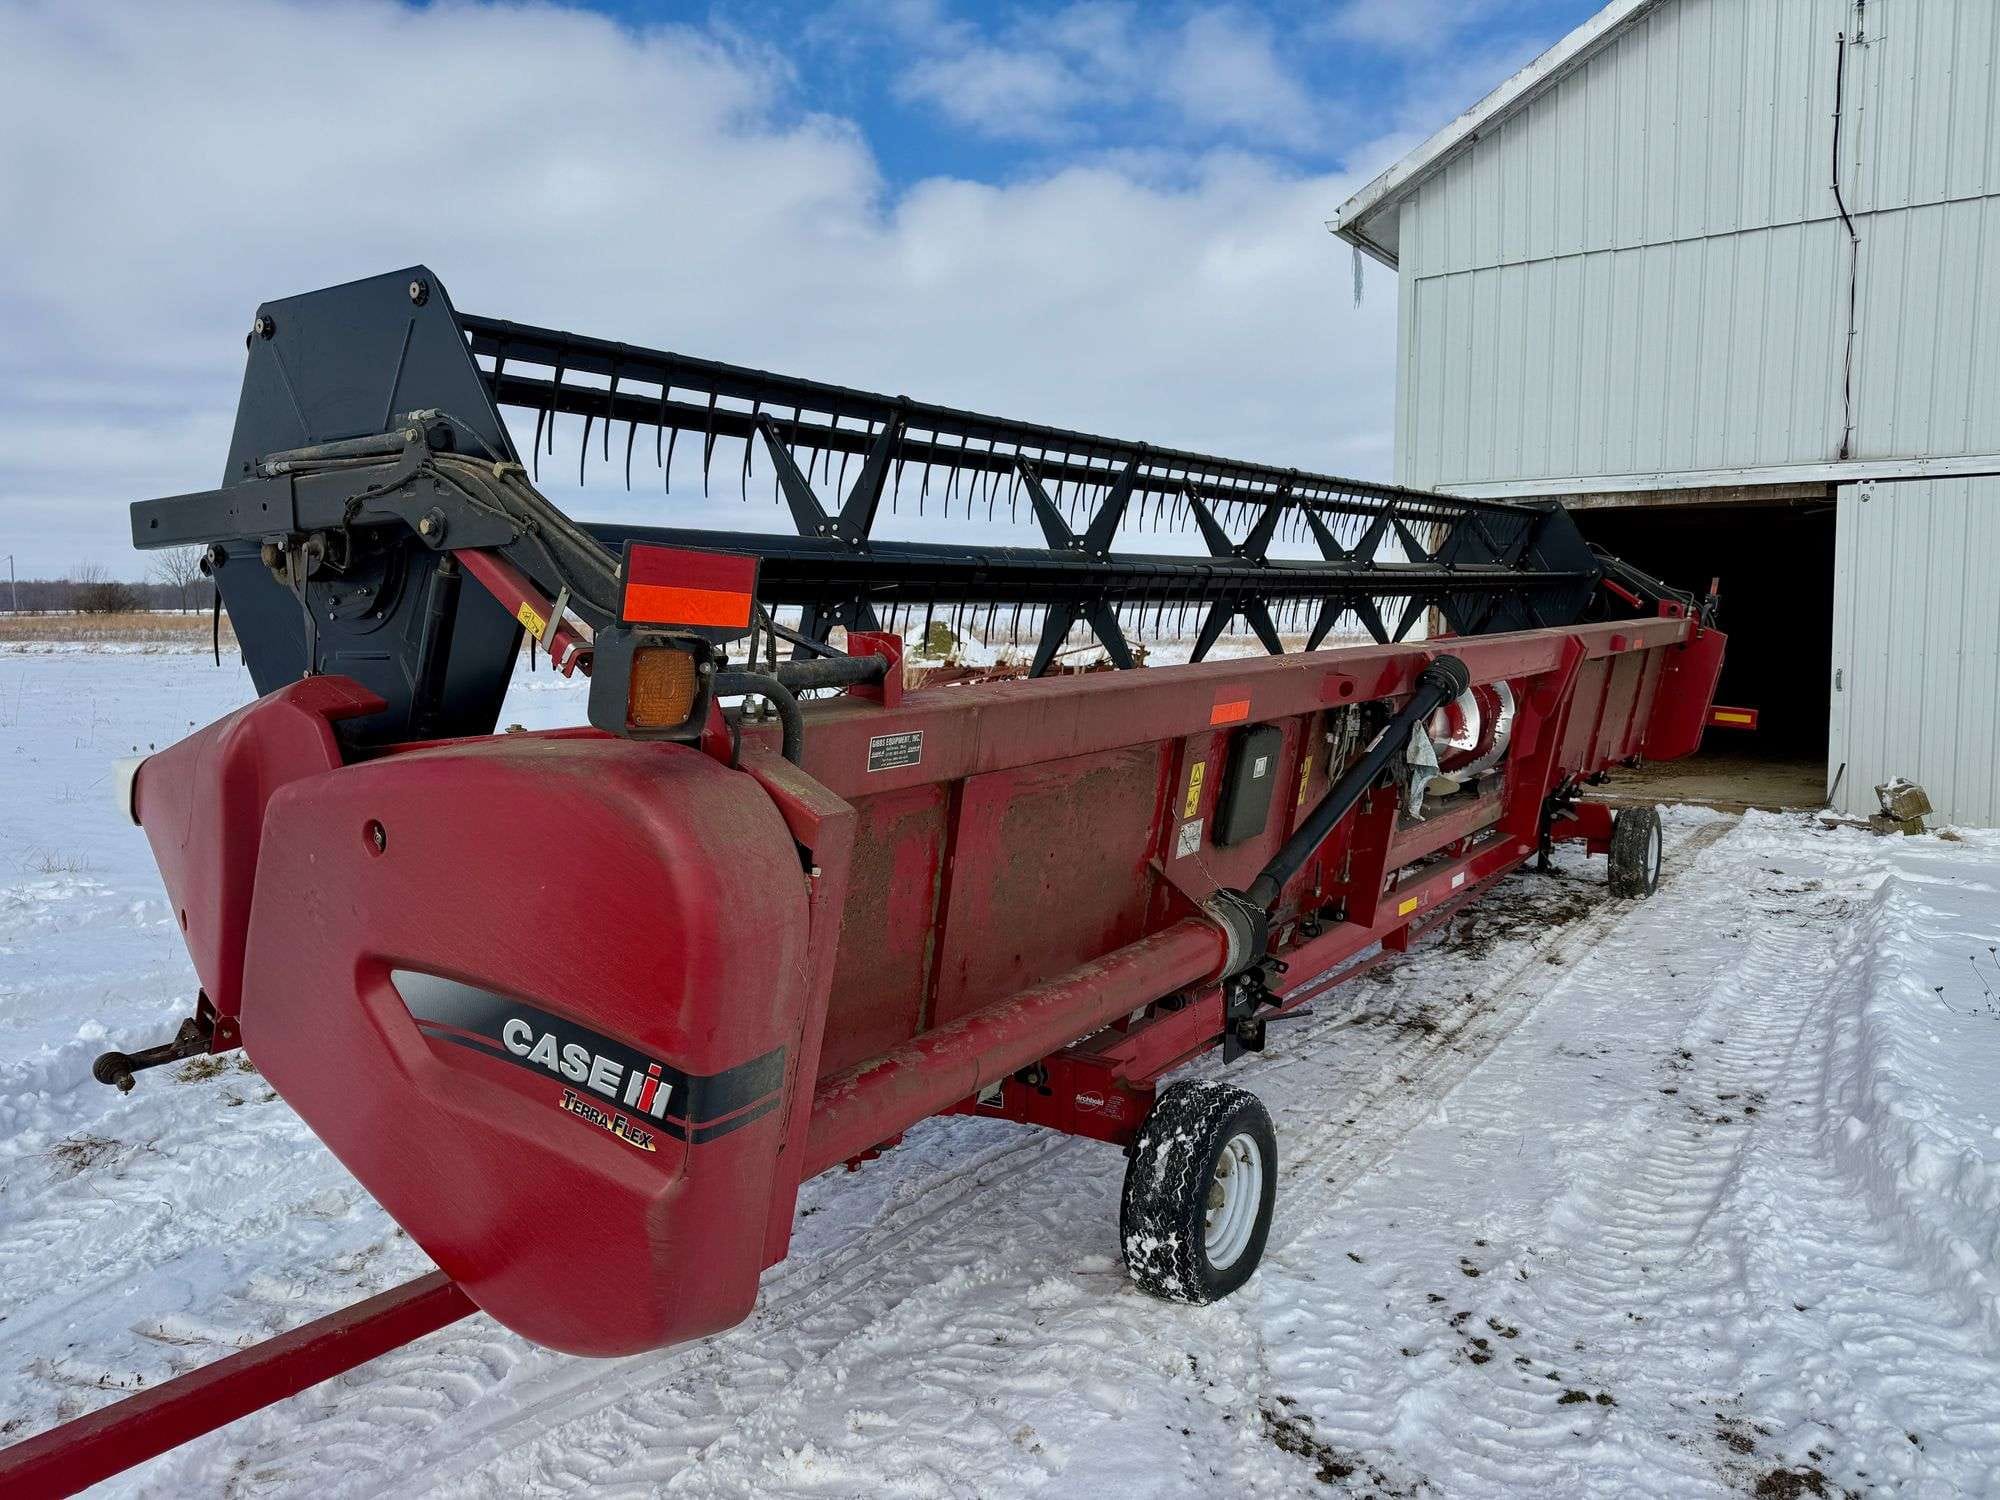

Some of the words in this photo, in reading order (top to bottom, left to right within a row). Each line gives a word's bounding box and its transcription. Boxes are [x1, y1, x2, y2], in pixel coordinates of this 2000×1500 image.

[502, 1017, 624, 1098] CASE
[560, 1088, 610, 1129] TERRA
[610, 1112, 654, 1150] FLEX
